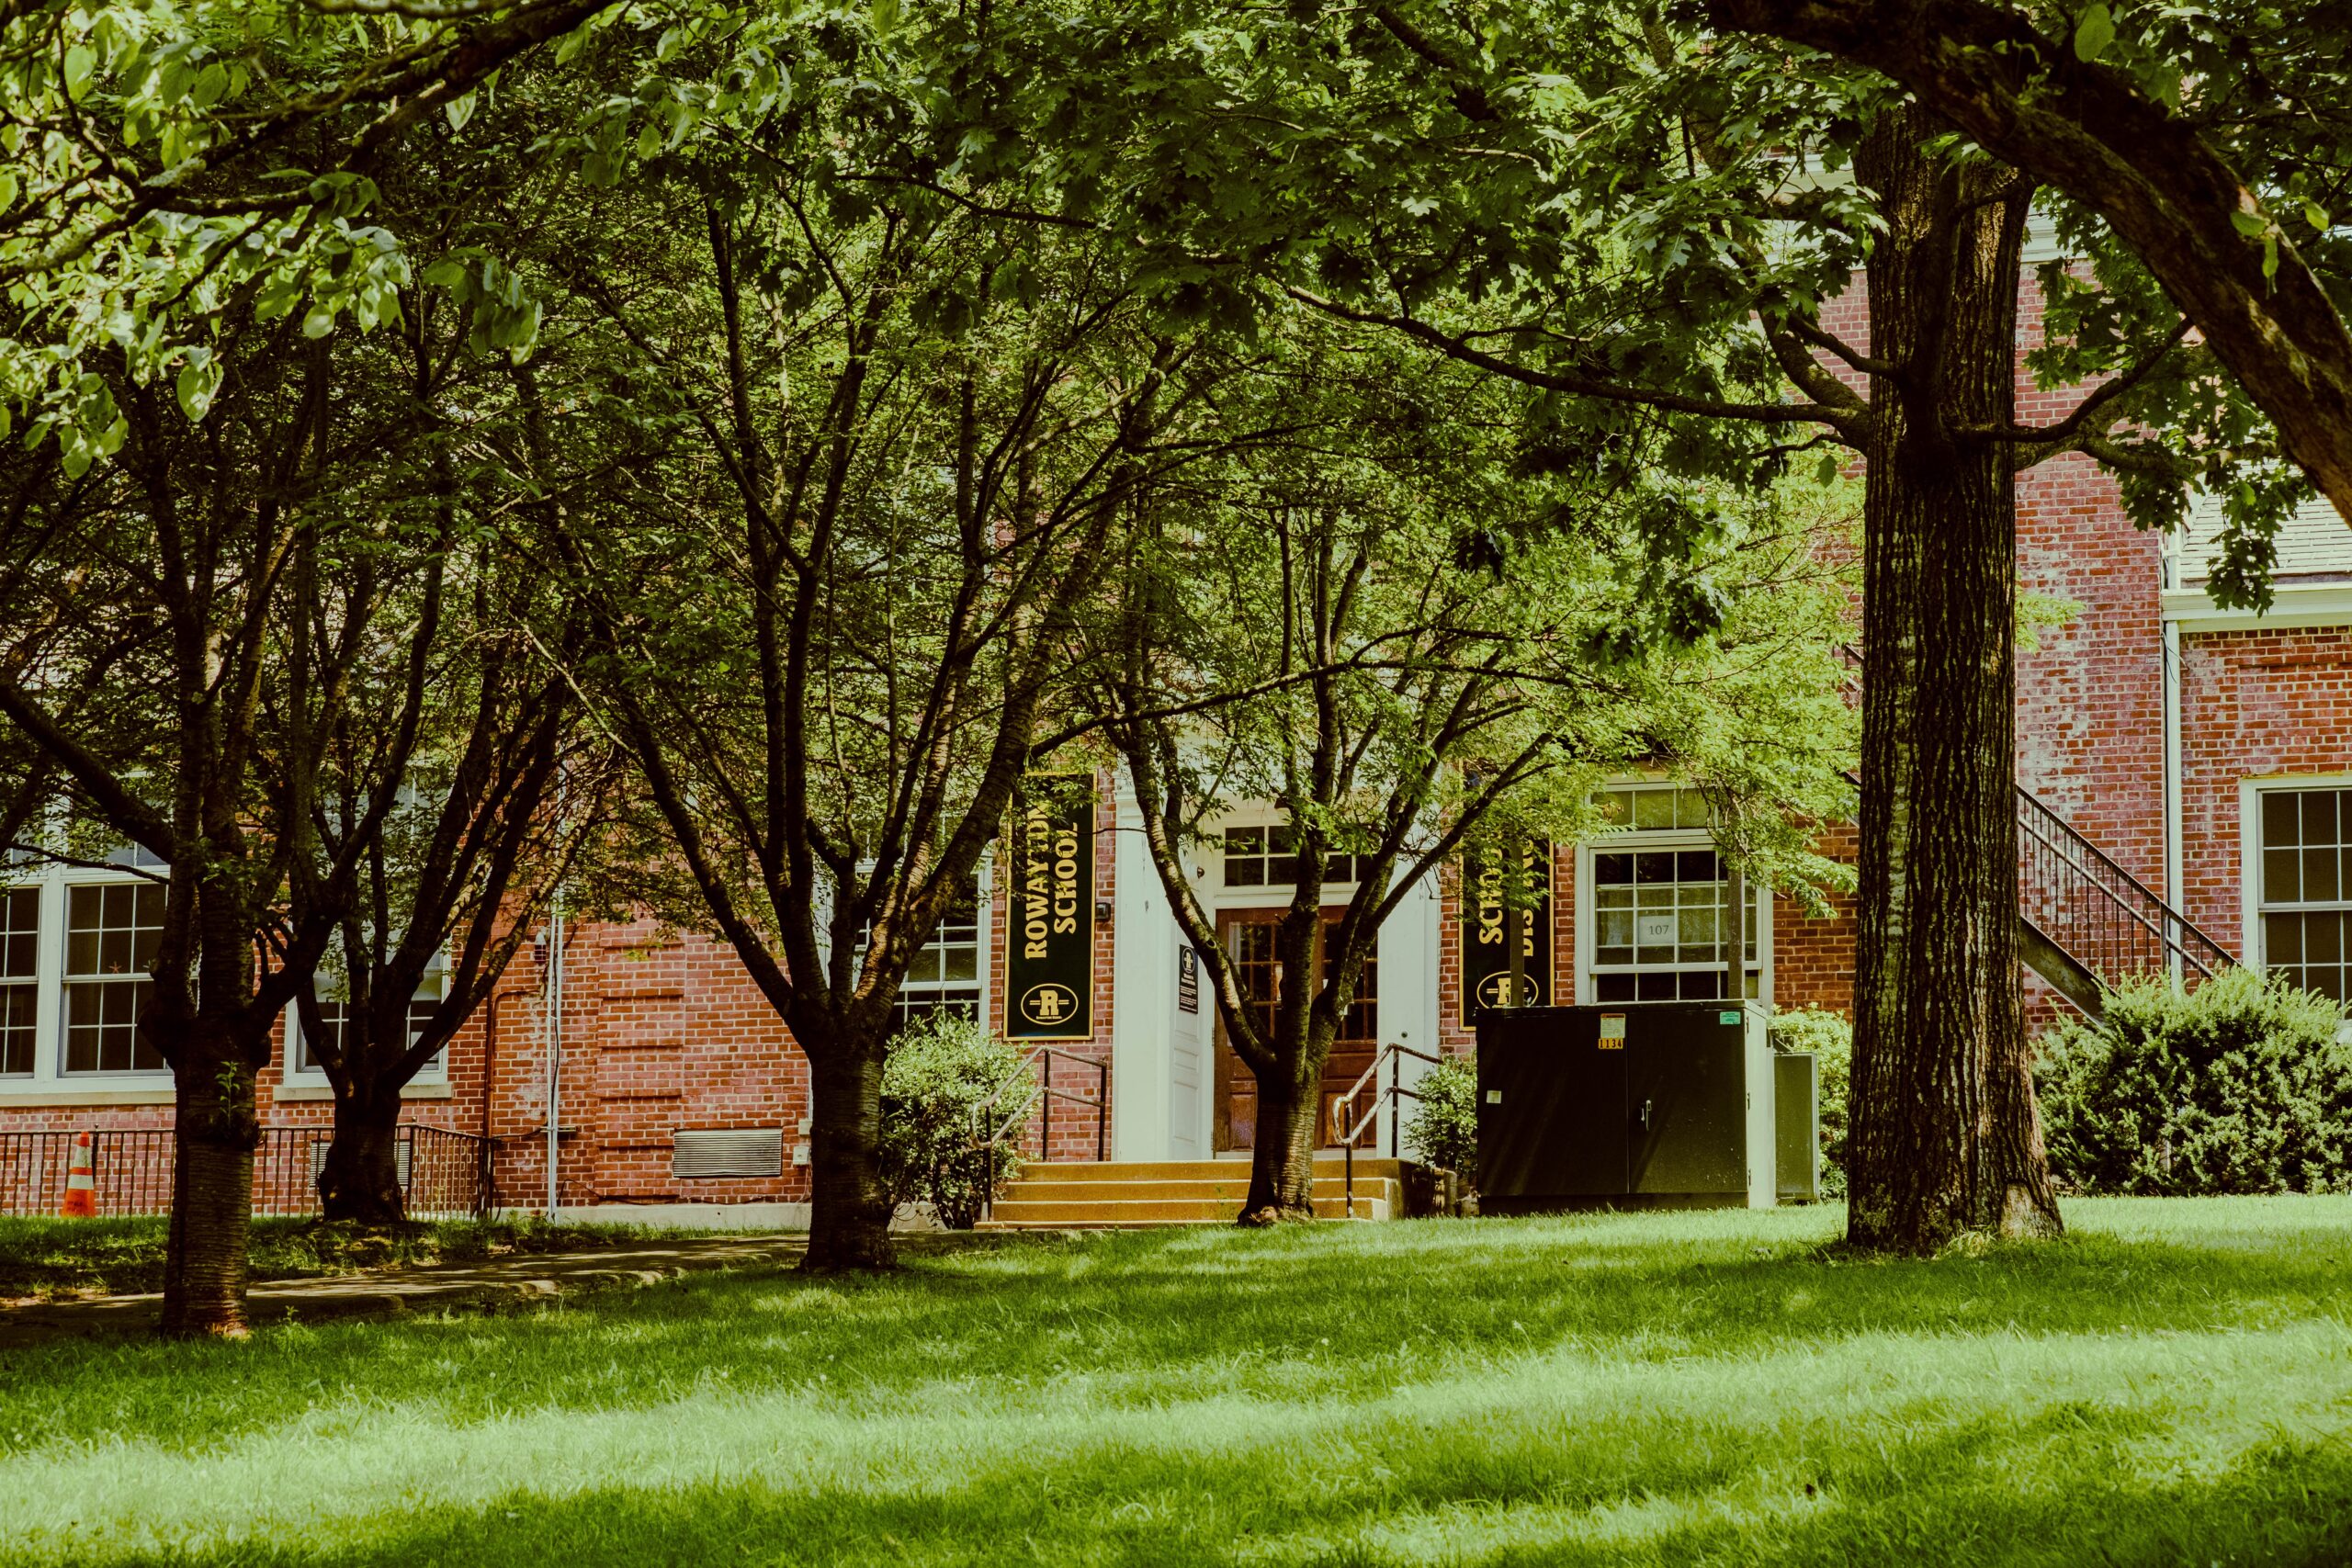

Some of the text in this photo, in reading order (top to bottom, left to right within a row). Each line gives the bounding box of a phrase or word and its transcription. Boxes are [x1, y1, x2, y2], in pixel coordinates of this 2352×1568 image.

[1054, 822, 1078, 934] SCHOOL
[1649, 925, 1669, 935] 107
[1039, 990, 1059, 1016] R
[1600, 1039, 1622, 1047] 1134
